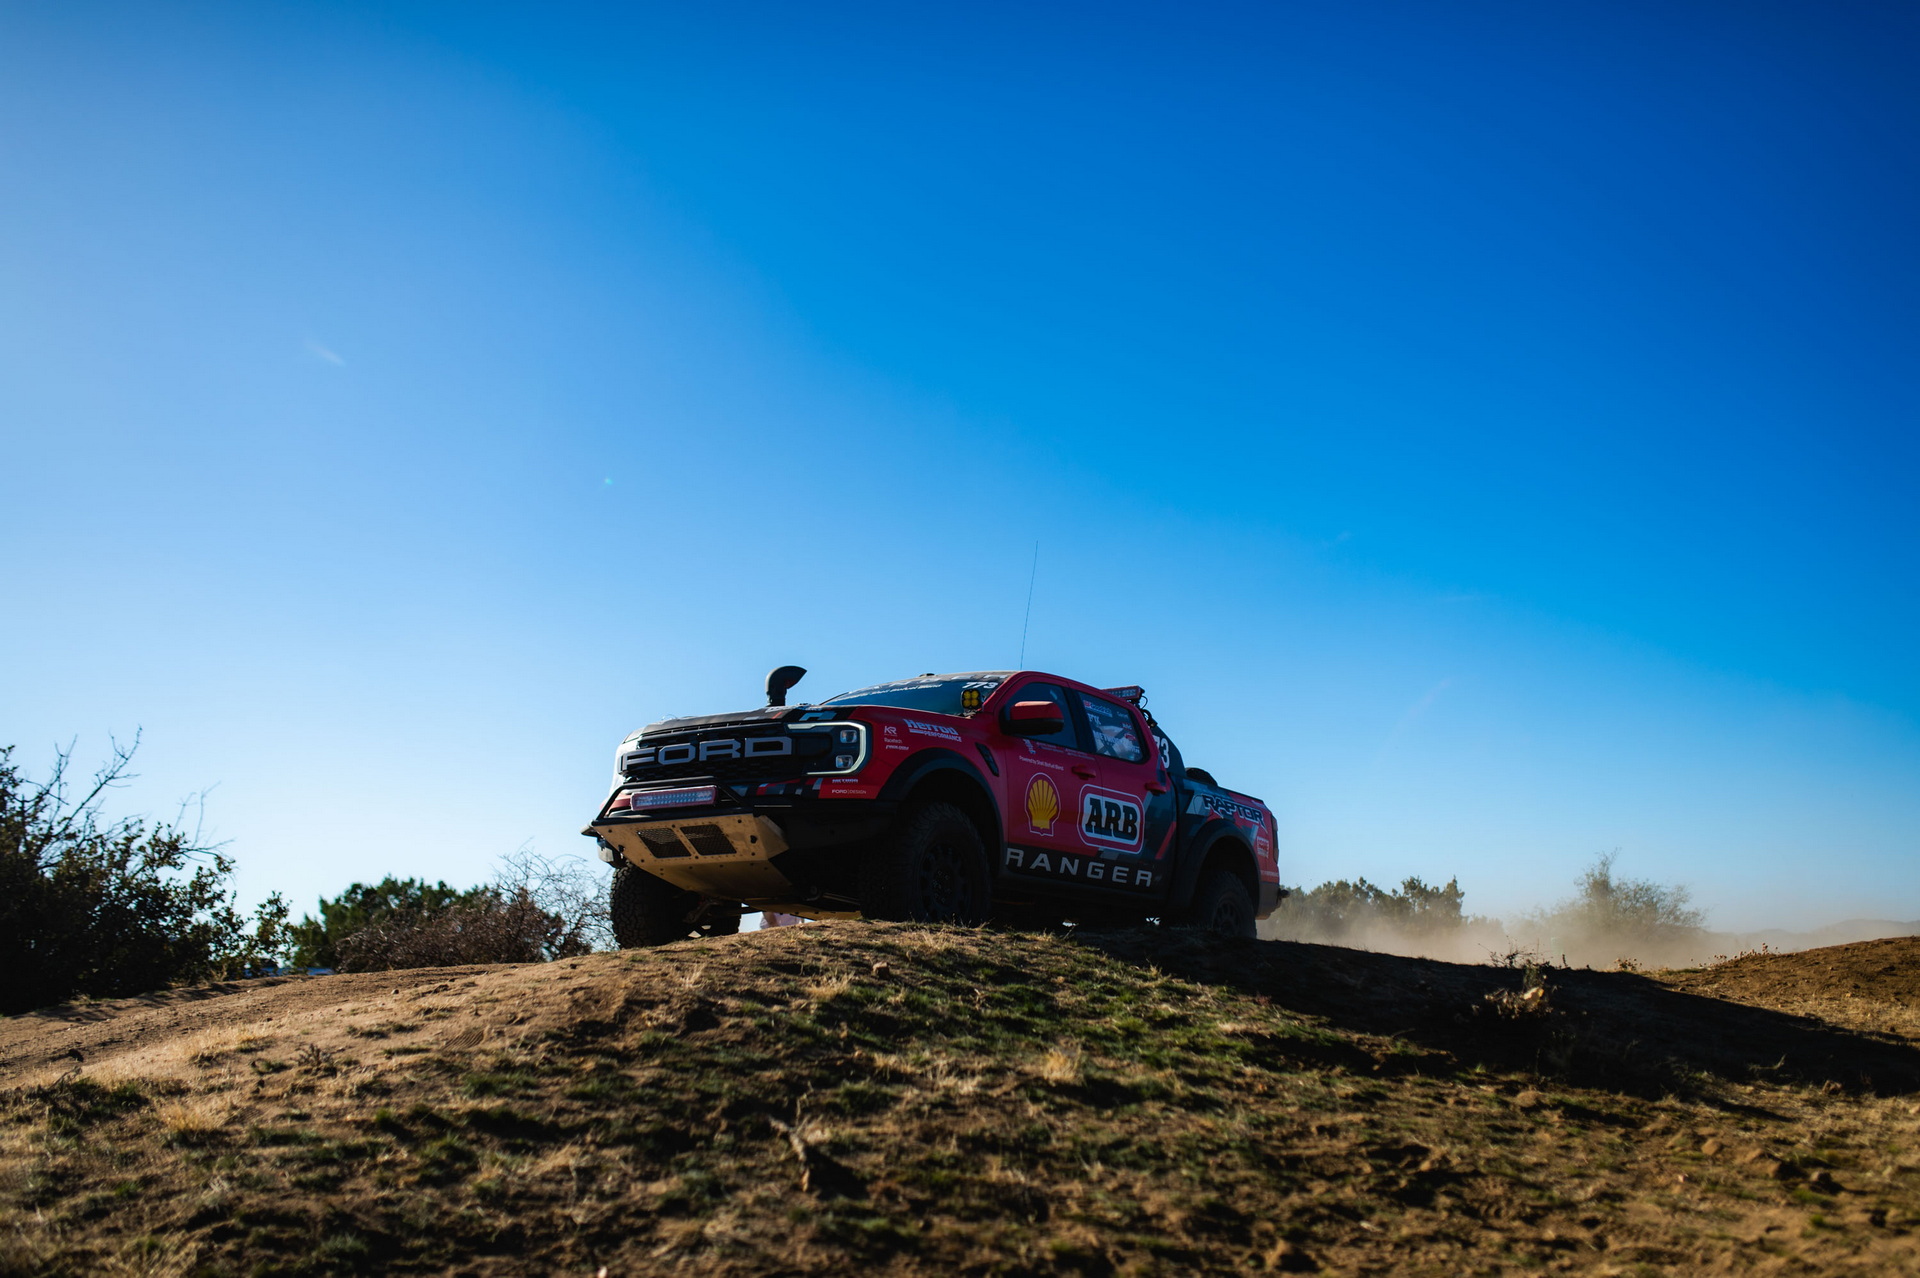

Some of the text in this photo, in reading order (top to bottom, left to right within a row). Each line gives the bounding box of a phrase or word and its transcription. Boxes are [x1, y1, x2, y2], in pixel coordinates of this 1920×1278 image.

[962, 681, 999, 689] 773
[924, 731, 962, 742] PERFORMANCE
[618, 737, 793, 776] FORD
[1085, 797, 1138, 841] ARB
[1202, 793, 1268, 834] RAPTOR
[1005, 848, 1153, 887] RANGER
